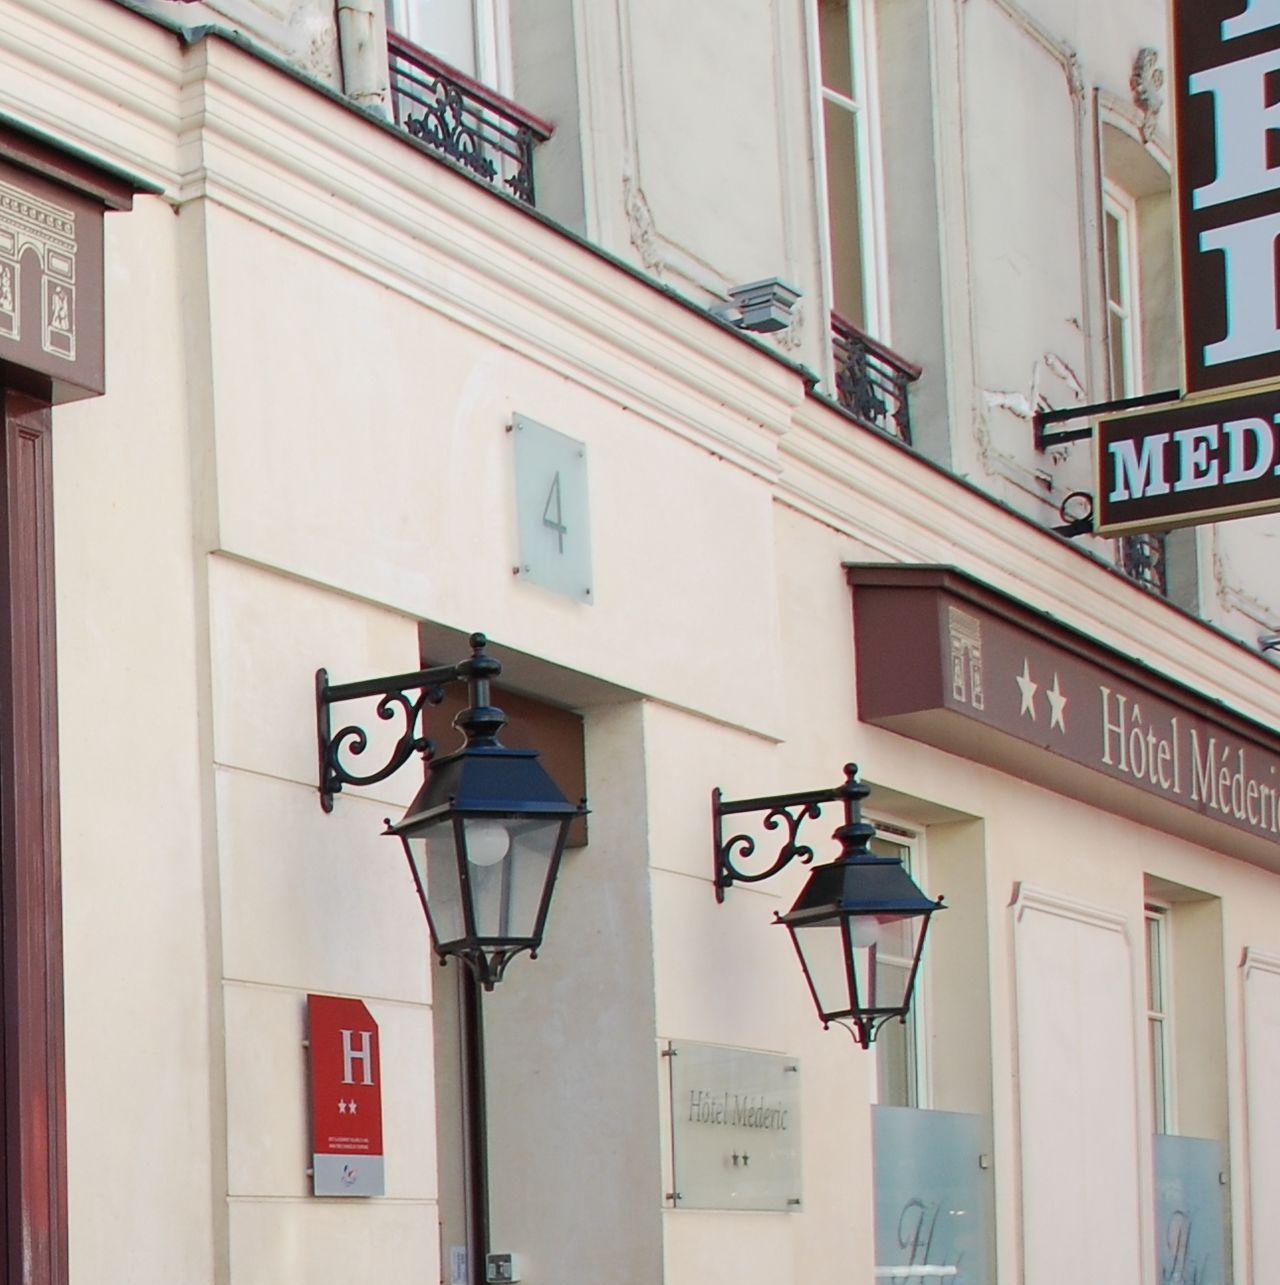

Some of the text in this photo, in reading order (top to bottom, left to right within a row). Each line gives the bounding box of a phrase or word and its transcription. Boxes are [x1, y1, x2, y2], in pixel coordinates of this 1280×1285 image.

[1108, 412, 1280, 503] MED
[542, 470, 567, 554] 4
[1099, 685, 1280, 832] Hôtel Méderi
[340, 1028, 374, 1085] H
[688, 1089, 729, 1125] Hôtel
